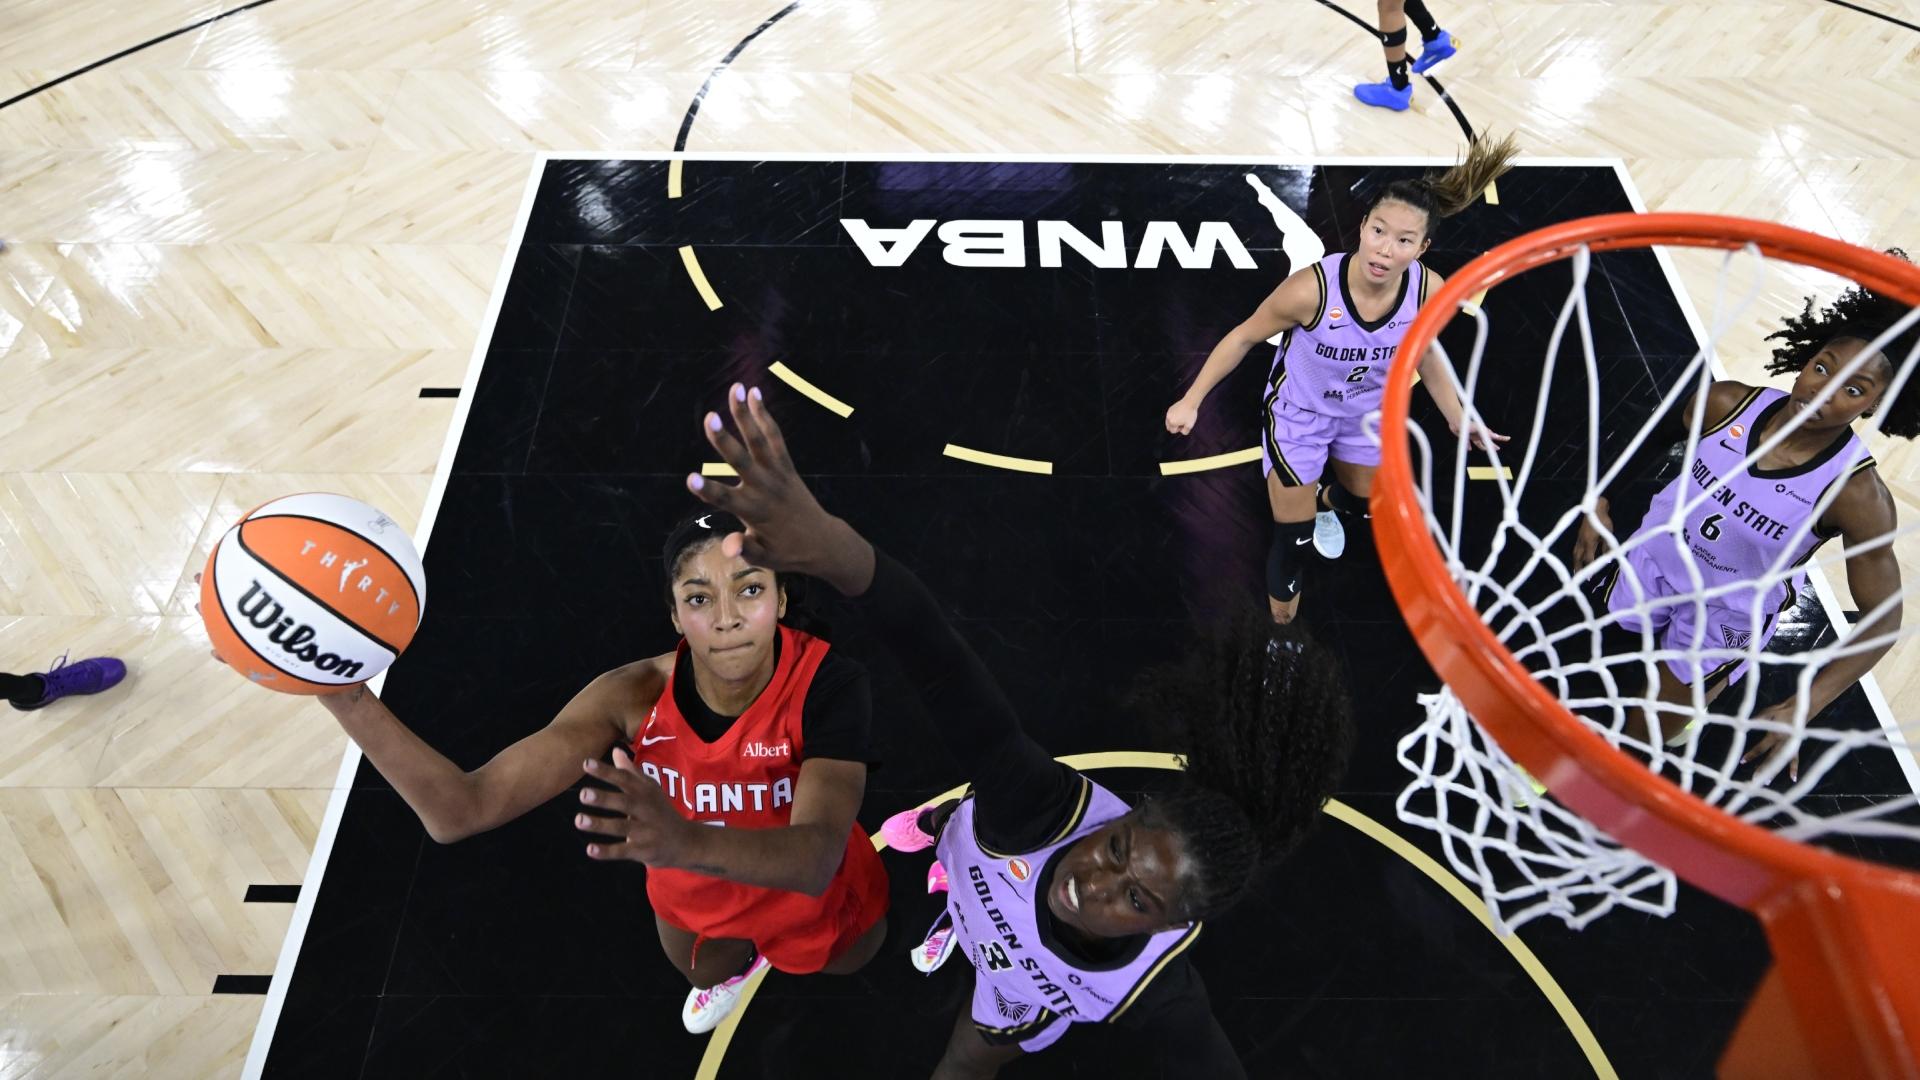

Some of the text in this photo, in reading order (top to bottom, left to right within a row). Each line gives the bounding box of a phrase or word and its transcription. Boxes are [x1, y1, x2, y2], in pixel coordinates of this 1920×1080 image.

[839, 218, 1259, 270] WNBA
[1315, 342, 1398, 362] GOLDEN STA
[1346, 365, 1370, 383] 2
[1700, 513, 1725, 541] 6
[1732, 501, 1789, 541] STATE
[236, 577, 365, 679] Wilson
[743, 741, 789, 758] Albert
[968, 864, 1080, 1019] GOLDEN STATE
[977, 940, 1014, 972] 3
